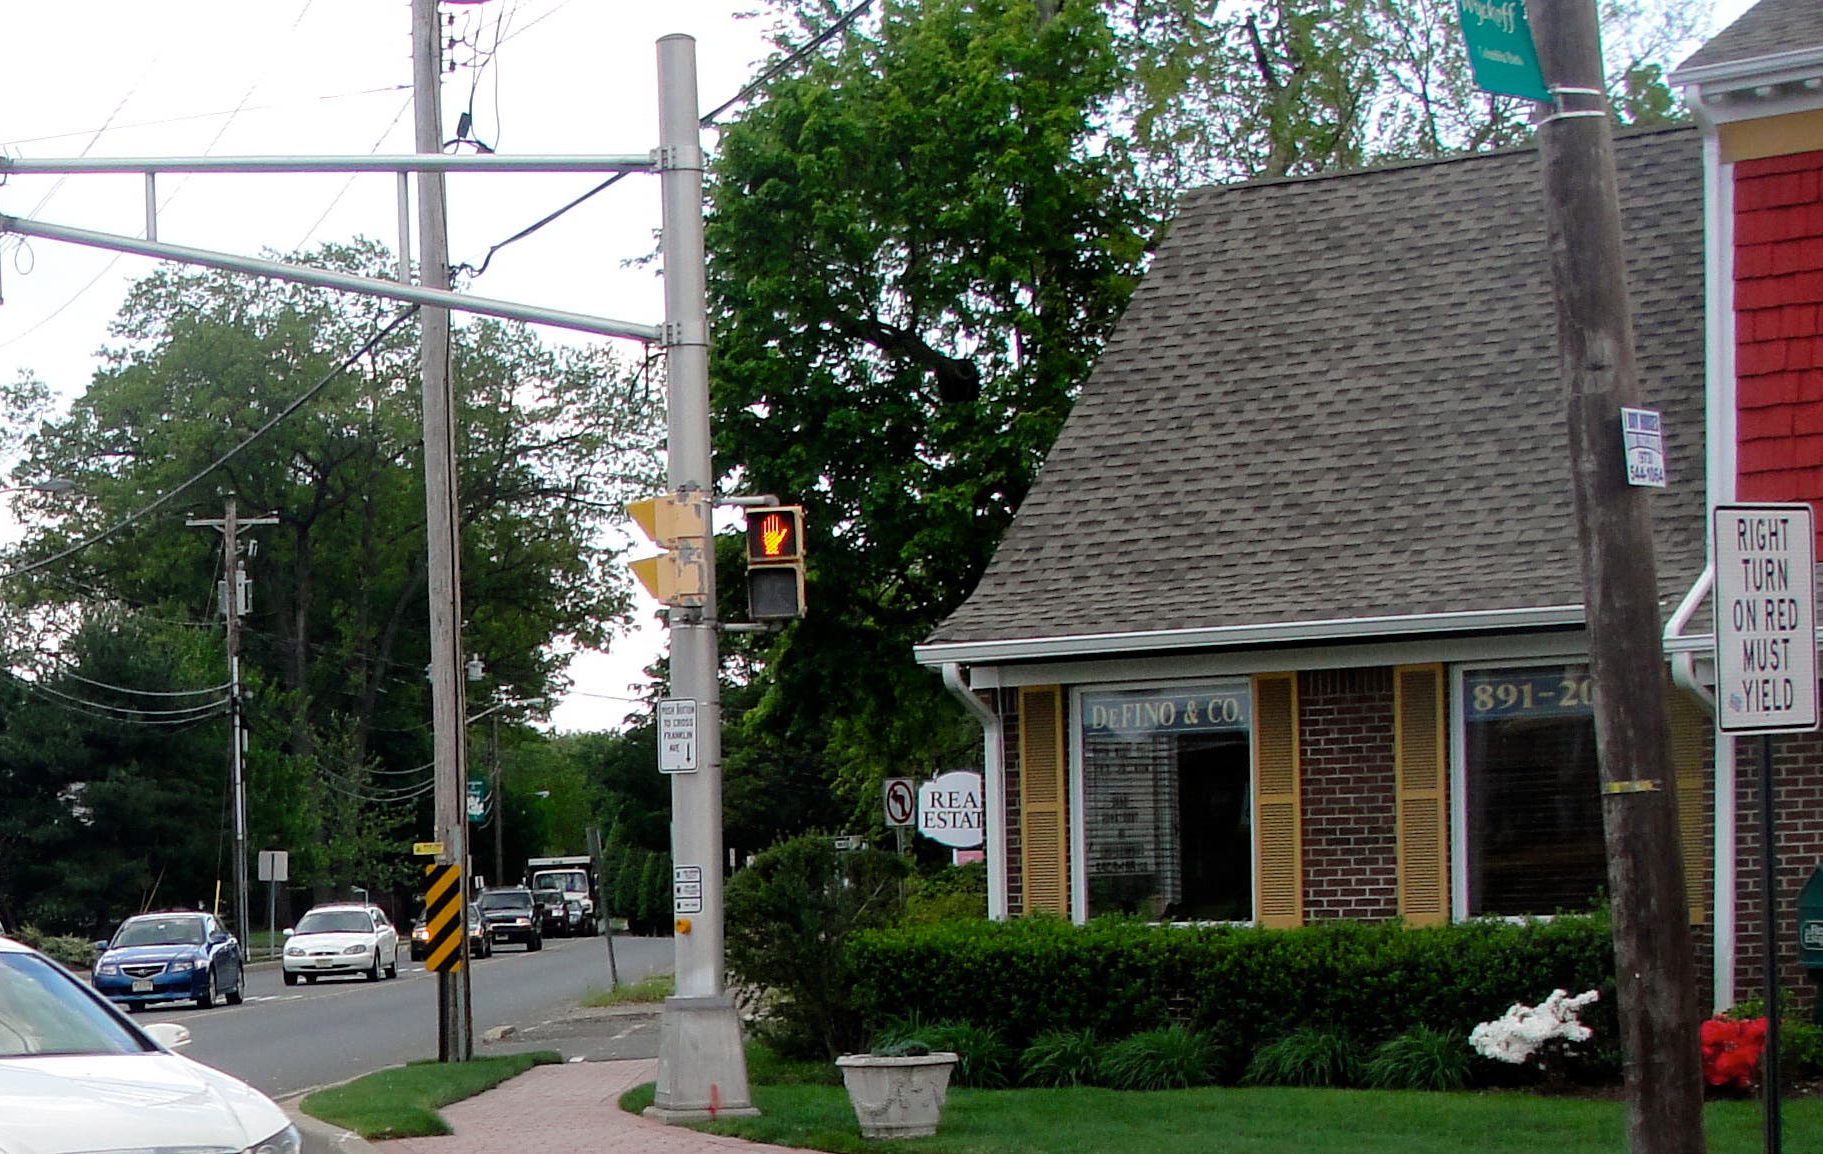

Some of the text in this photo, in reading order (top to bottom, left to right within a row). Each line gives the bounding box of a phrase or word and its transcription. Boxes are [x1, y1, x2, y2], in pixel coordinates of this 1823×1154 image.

[1737, 518, 1789, 551] RIGHT
[1741, 558, 1789, 592] TURN
[1733, 598, 1798, 632] ON RED
[1742, 638, 1790, 673] MUST
[1183, 700, 1199, 725] &
[1207, 698, 1244, 724] CO.
[1473, 679, 1594, 712] 891-20
[1742, 678, 1794, 713] YIELD
[930, 790, 982, 809] REA
[922, 811, 984, 829] ESTAT
